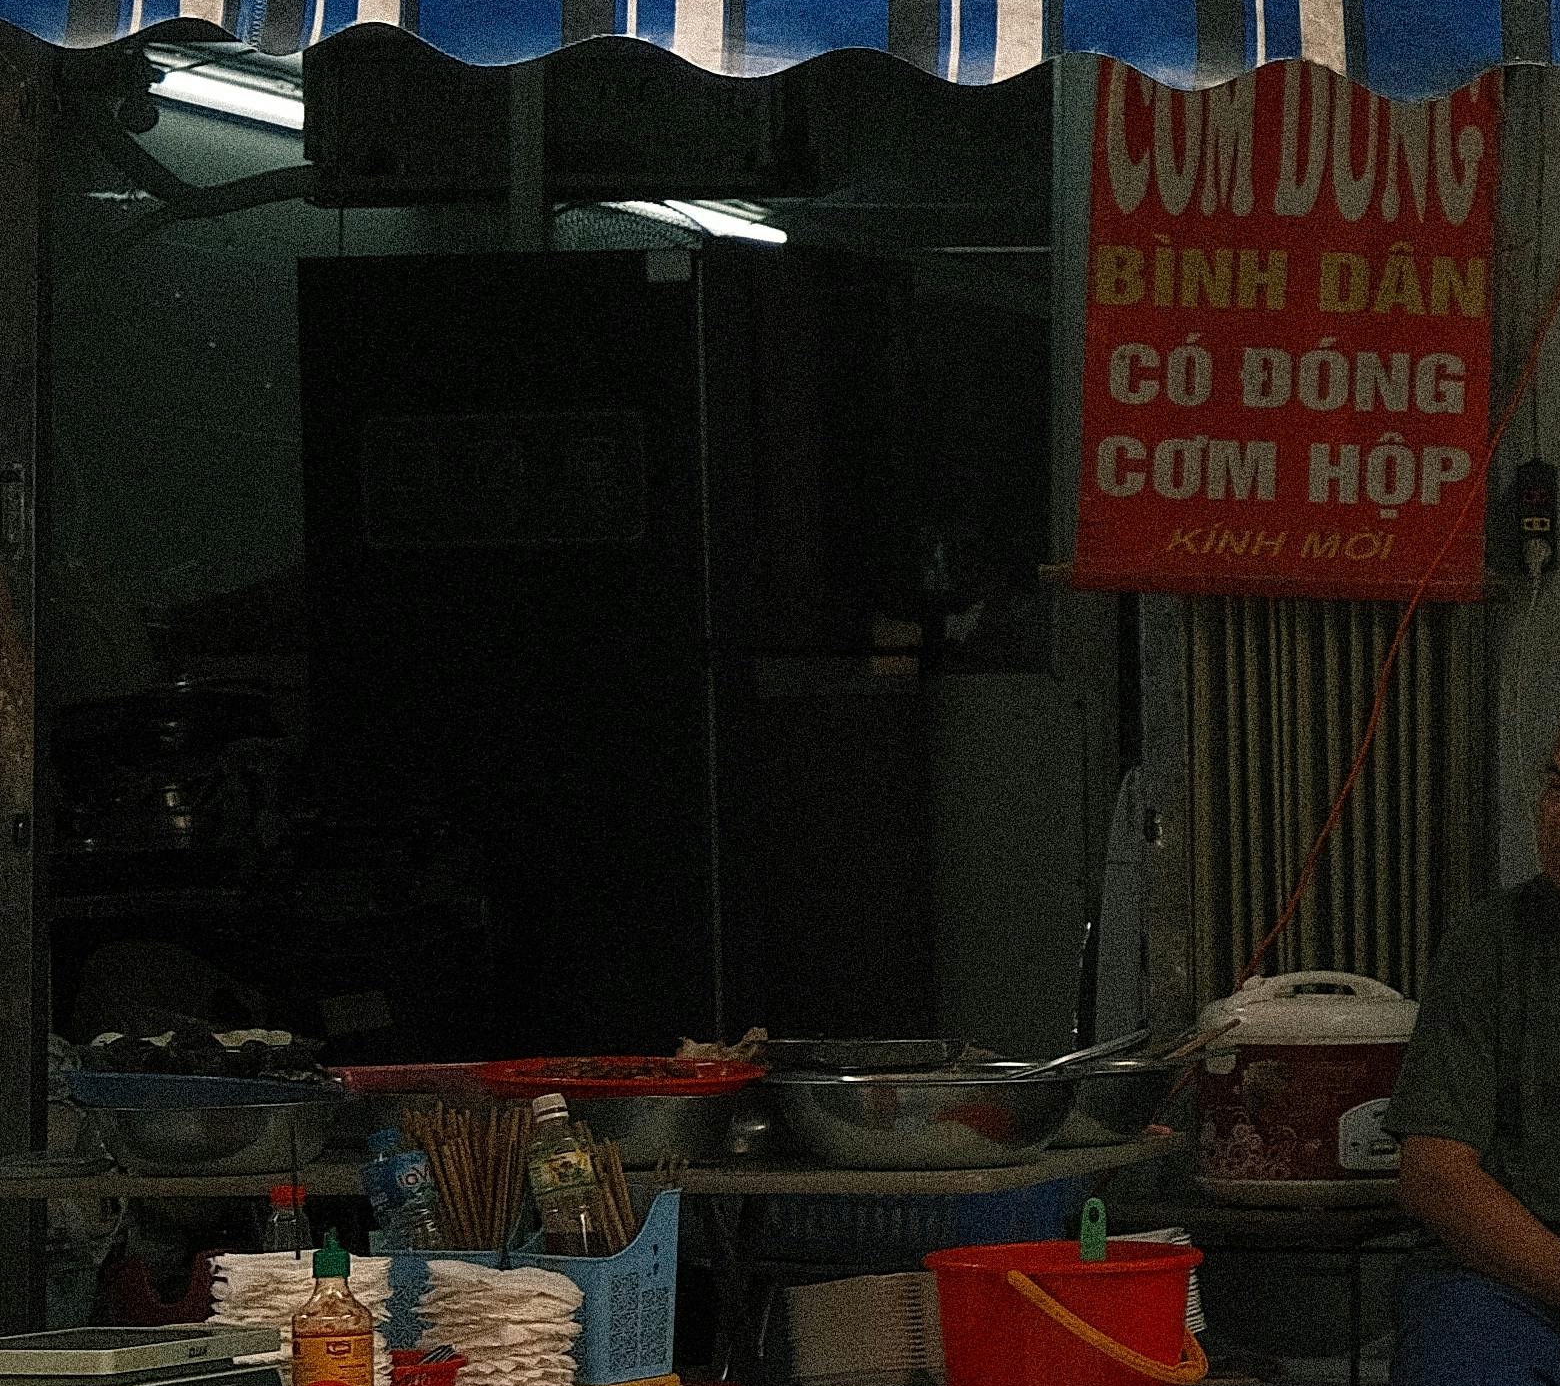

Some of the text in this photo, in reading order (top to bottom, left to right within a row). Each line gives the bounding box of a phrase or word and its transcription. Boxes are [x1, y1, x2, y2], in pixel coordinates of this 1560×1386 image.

[1097, 233, 1487, 318] BÌNH DÂN
[1108, 331, 1467, 414] CÓ ĐÓNG
[1097, 431, 1472, 519] CƠM HỘP
[1167, 523, 1286, 558] KÍNH
